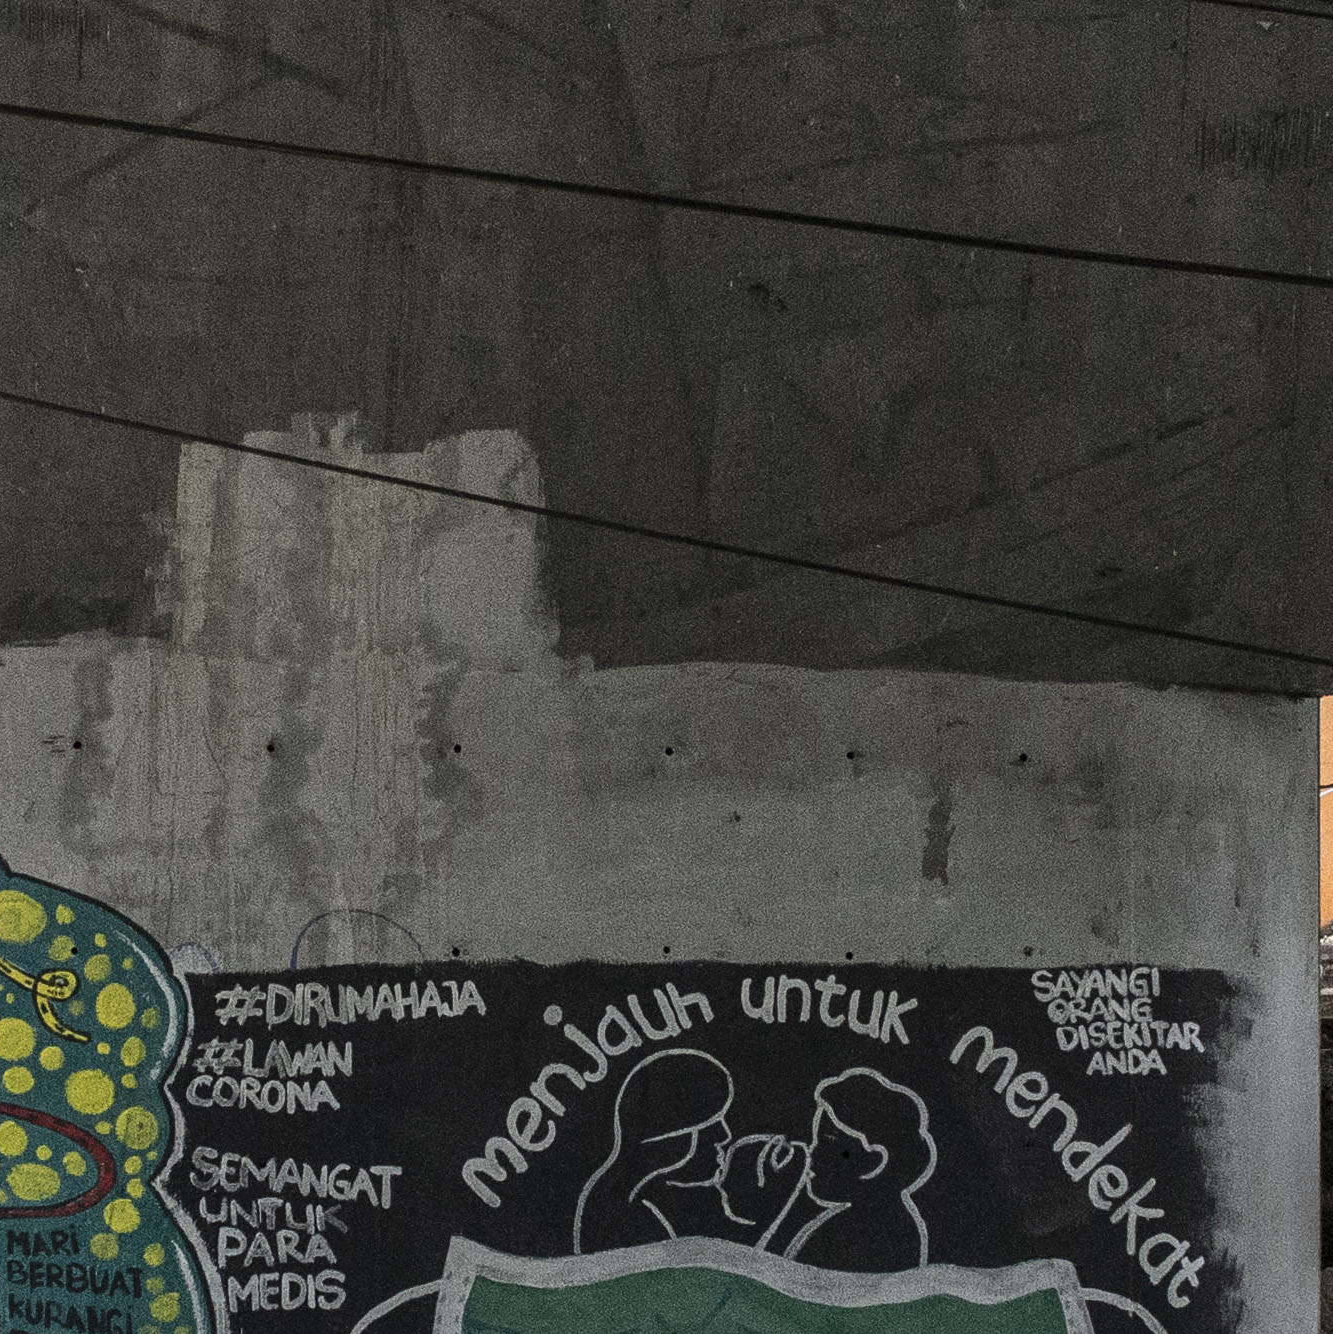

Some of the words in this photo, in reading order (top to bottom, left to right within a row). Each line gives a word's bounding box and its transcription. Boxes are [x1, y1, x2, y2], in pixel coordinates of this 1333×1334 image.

[1031, 966, 1161, 1002] SAYANGI
[215, 980, 487, 1030] #DIRUMAHAJA
[1047, 997, 1153, 1024] ORANG
[1056, 1020, 1205, 1053] DISEKITAR
[193, 1036, 353, 1077] #LAWAN
[1086, 1048, 1168, 1076] ANDA
[186, 1075, 341, 1114] CORONA
[740, 974, 918, 1045] untuk
[950, 1026, 1206, 1309] mendekat
[189, 1146, 403, 1209] SEMANGAT
[199, 1196, 348, 1235] UNTUK
[217, 1227, 337, 1268] PARA
[6, 1260, 143, 1299] BERBUAT
[227, 1269, 347, 1313] MEDIS
